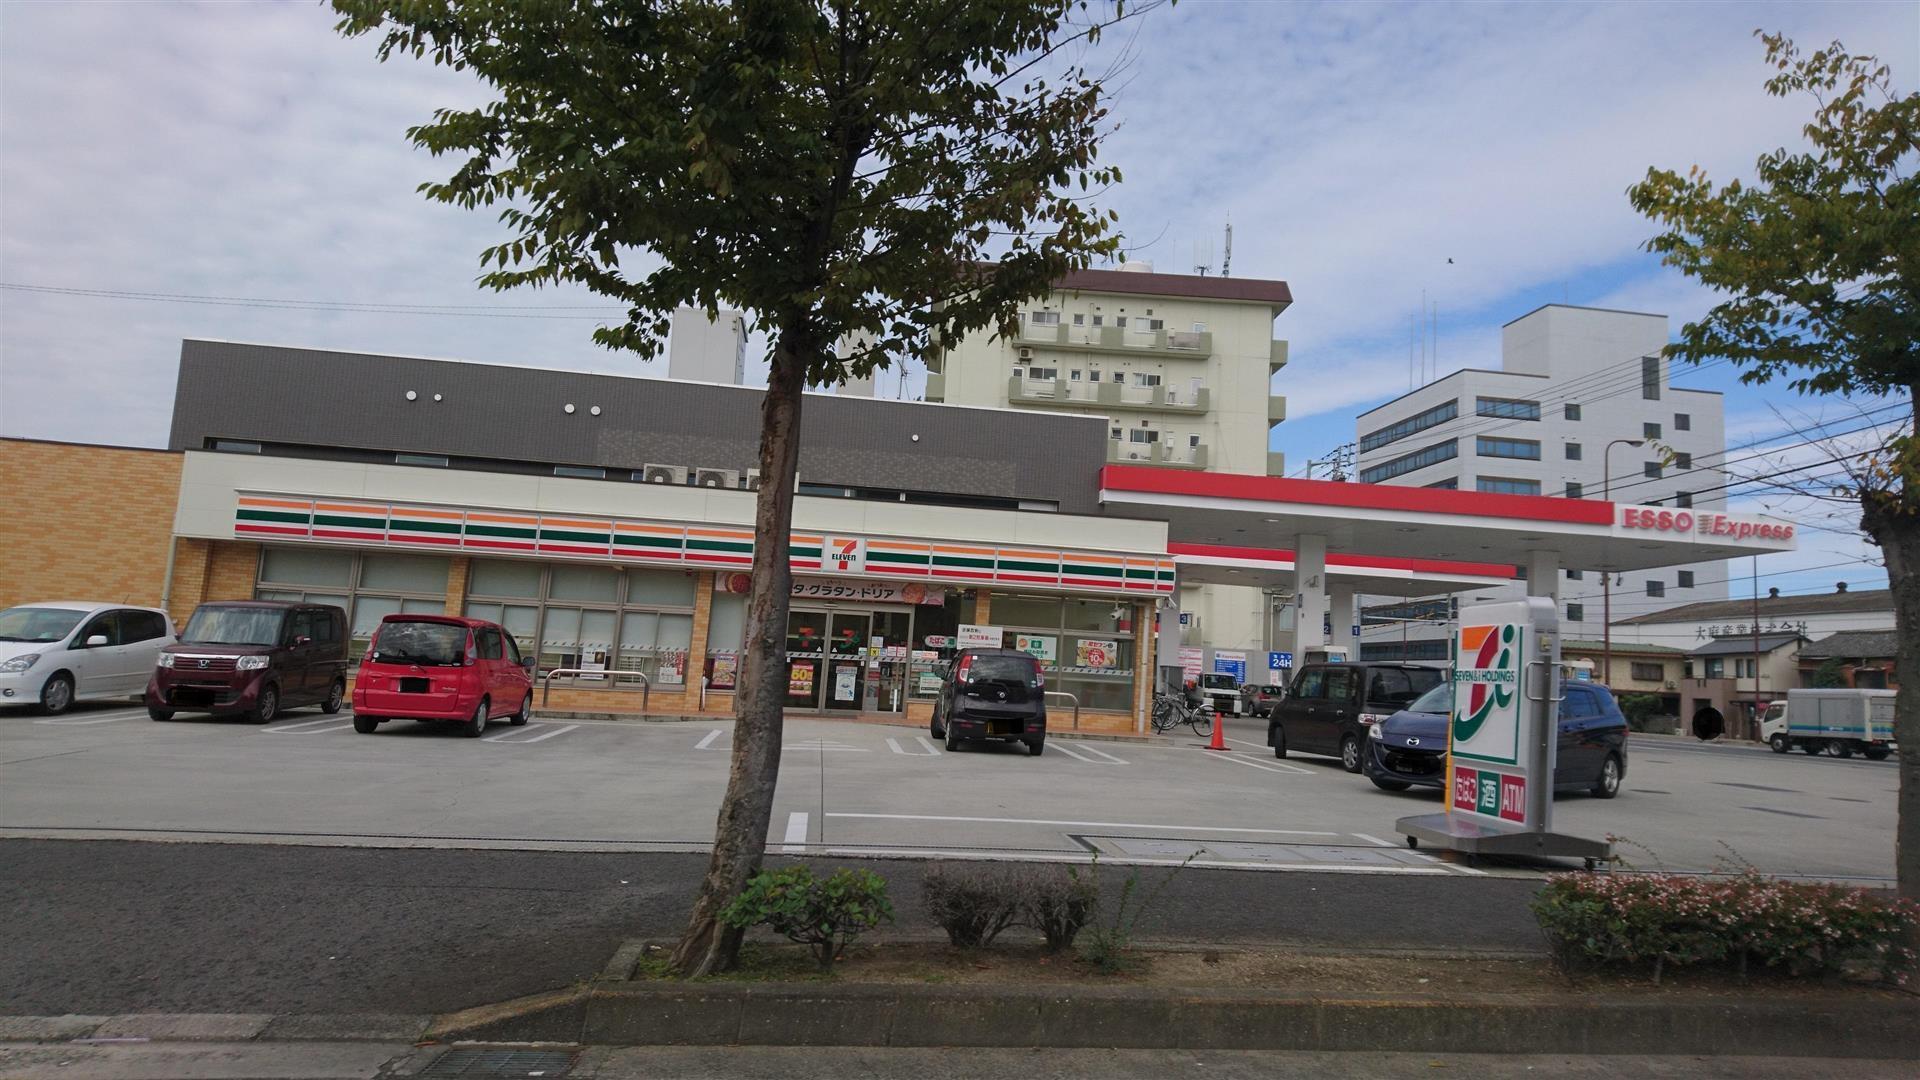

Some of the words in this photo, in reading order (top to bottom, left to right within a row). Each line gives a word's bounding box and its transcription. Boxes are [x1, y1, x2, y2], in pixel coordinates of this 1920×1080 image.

[1623, 508, 1694, 533] ESSO
[1711, 514, 1794, 541] Express
[792, 583, 895, 600] タ・グラタン・ドリア
[1181, 615, 1188, 624] 3
[1272, 658, 1292, 668] 24H
[1482, 670, 1515, 681] HOLDINGS
[1456, 775, 1477, 803] たばこ
[1481, 779, 1497, 808] 酒
[1502, 783, 1525, 815] ATM
